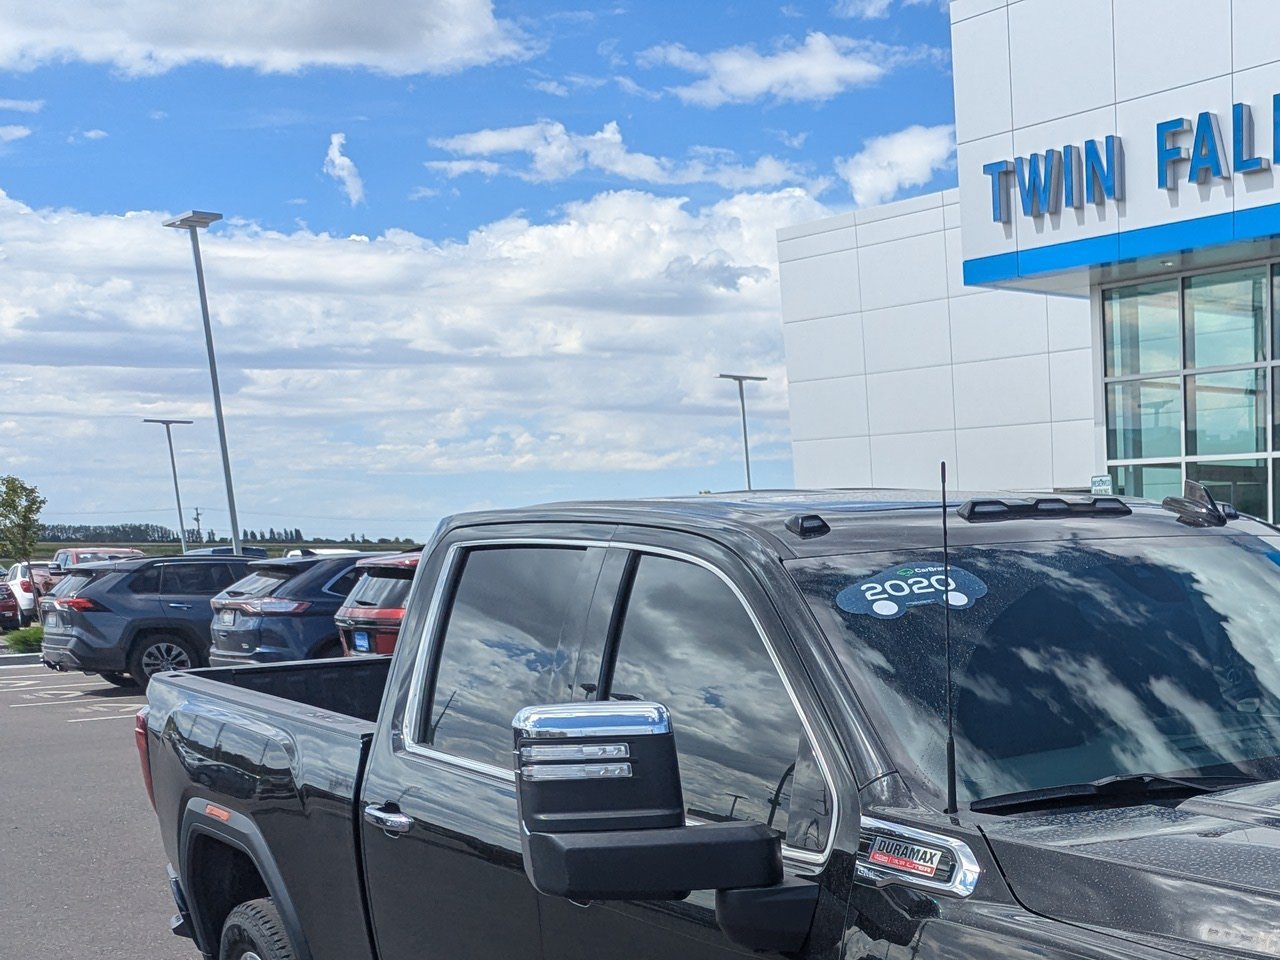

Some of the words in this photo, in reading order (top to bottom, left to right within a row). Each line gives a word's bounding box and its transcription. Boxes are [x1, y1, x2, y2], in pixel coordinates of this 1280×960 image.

[983, 135, 1122, 223] TWIN
[860, 575, 956, 600] 2020
[878, 839, 937, 866] DURAMAX
